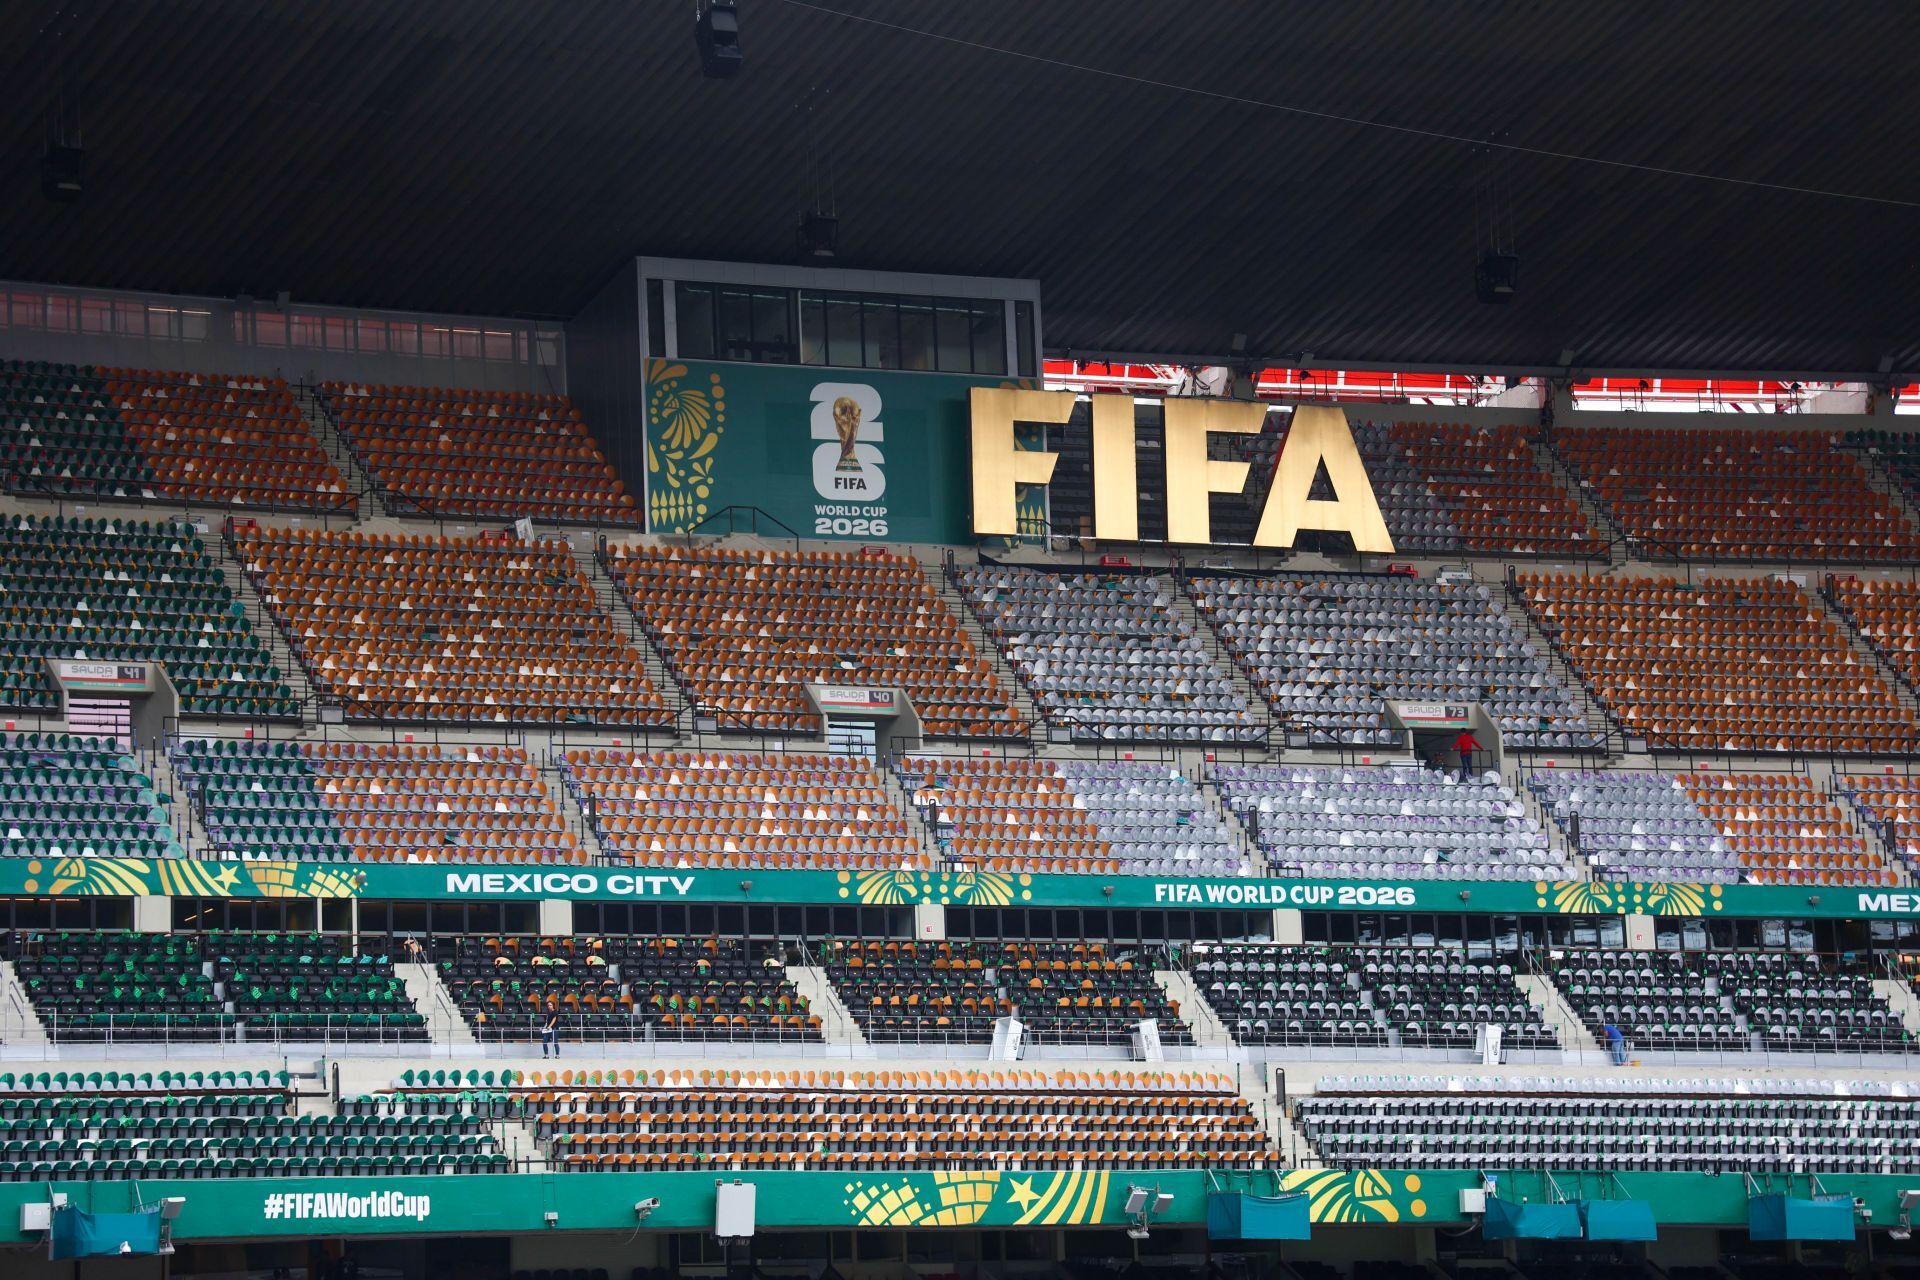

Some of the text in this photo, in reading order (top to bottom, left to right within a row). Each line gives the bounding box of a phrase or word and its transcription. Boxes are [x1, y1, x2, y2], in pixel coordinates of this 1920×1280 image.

[970, 387, 1395, 553] FIFA
[834, 477, 867, 490] FIFA
[814, 504, 888, 517] WORLD CUP
[814, 517, 888, 536] 2026
[71, 665, 140, 679] SALIDA 41
[829, 690, 890, 703] SALIDA 40
[1407, 705, 1442, 714] SALIDA
[1449, 707, 1465, 717] 73
[446, 873, 695, 895] MEXICO CITY
[1154, 883, 1416, 905] FIFA WORLD CUP 2026
[264, 1191, 431, 1222] #FIFAWorldCup
